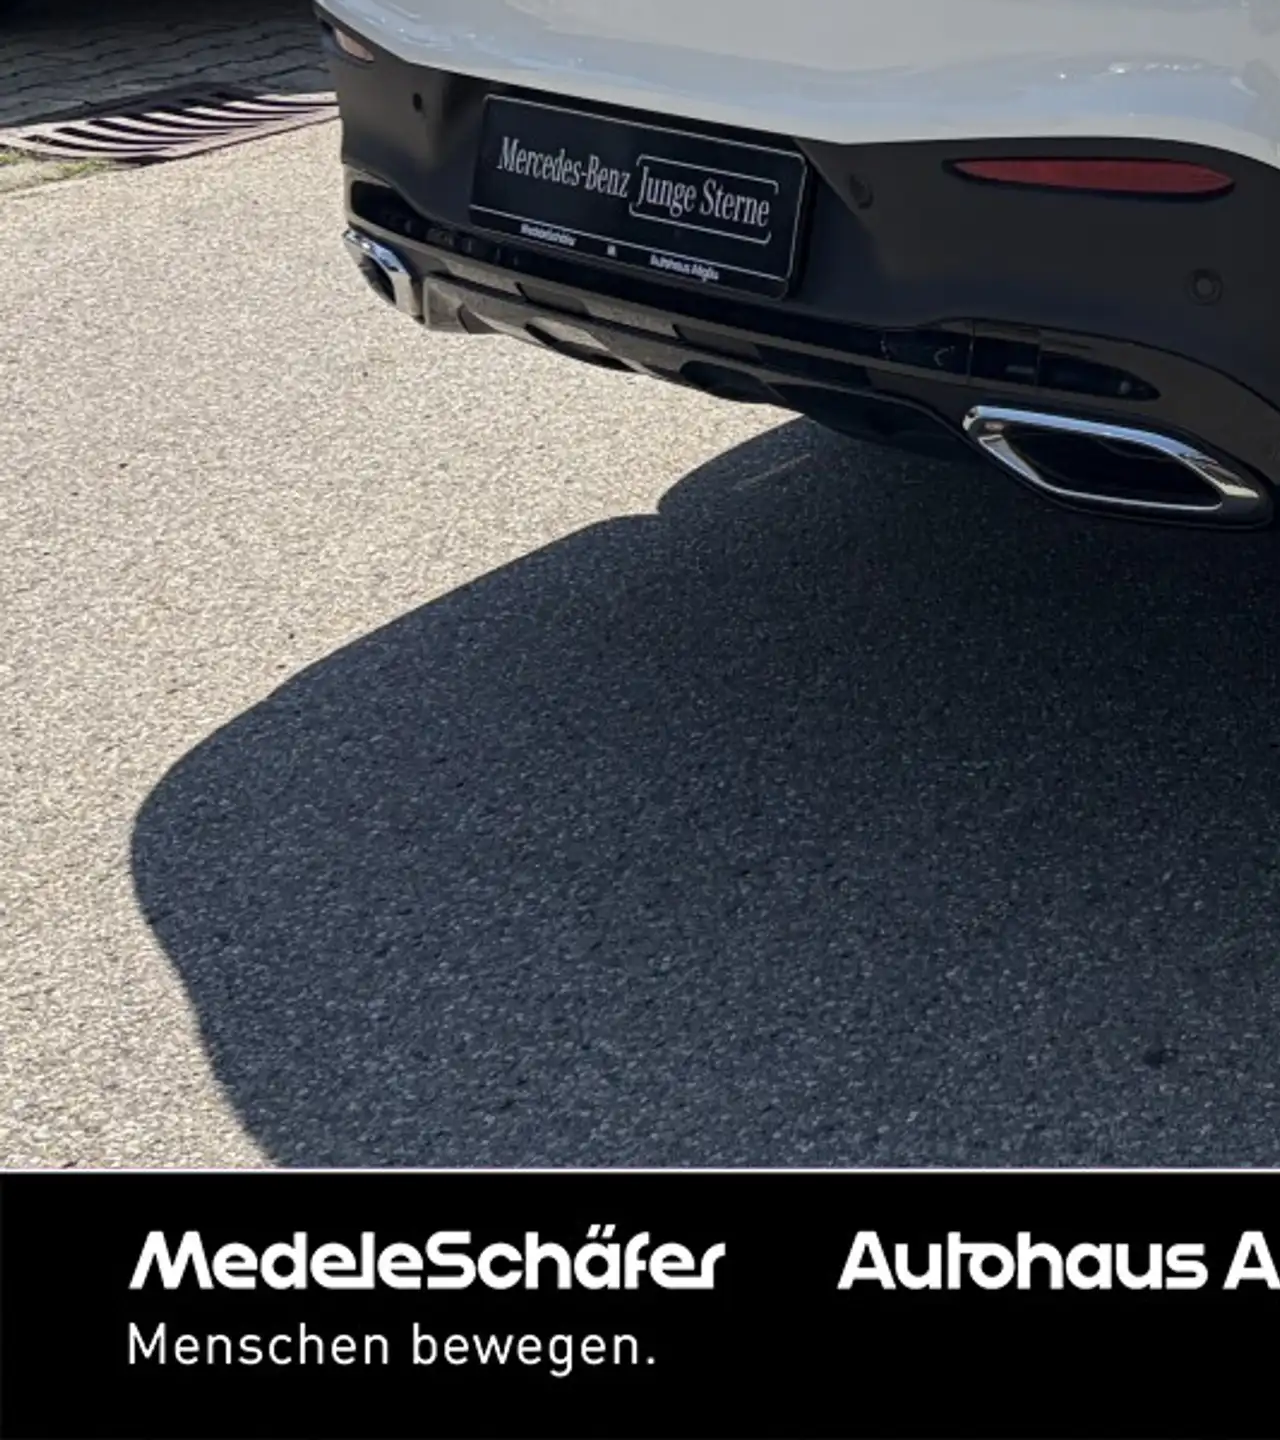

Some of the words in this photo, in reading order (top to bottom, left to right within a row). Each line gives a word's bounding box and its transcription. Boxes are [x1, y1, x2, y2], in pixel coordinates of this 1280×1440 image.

[496, 136, 632, 198] Mercedes-Benz
[636, 165, 697, 217] Junge
[699, 177, 771, 228] Sterne
